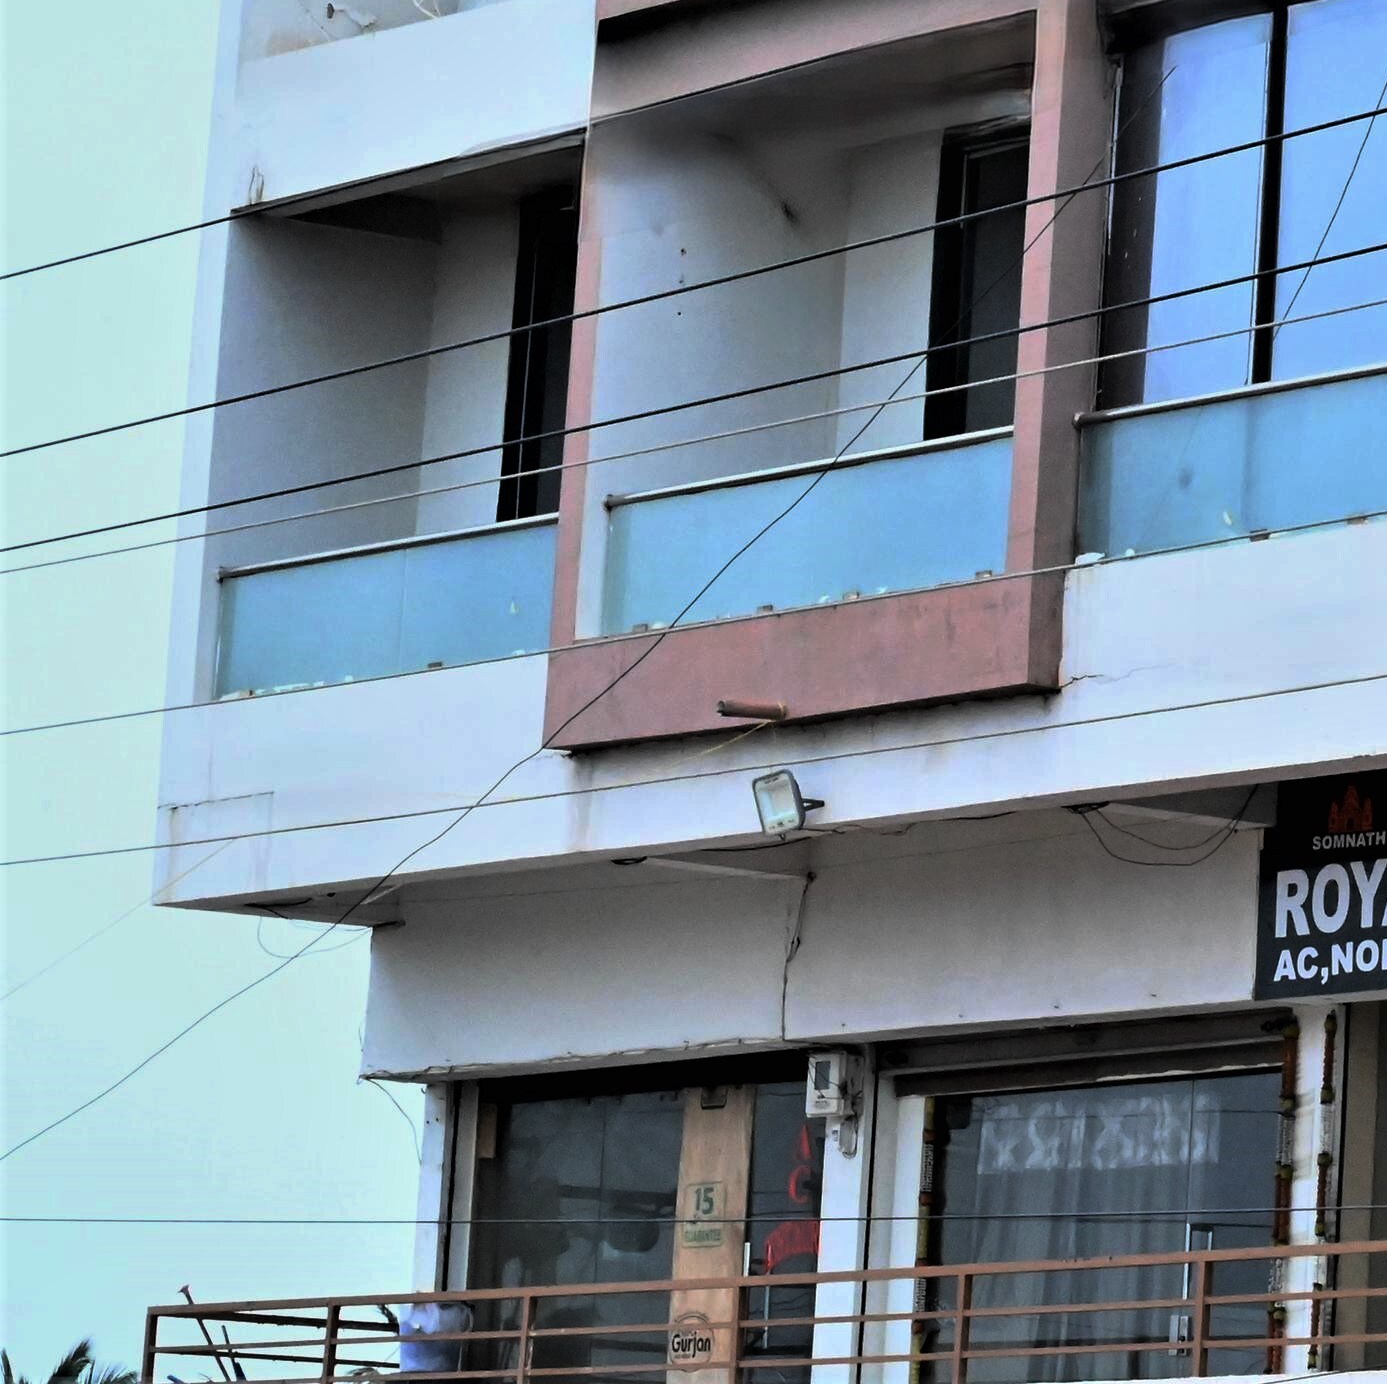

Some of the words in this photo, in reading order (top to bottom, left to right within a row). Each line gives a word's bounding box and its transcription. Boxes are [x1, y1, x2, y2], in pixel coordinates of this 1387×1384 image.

[1313, 831, 1386, 850] SOMNATH
[695, 1187, 714, 1214] 15
[672, 1331, 711, 1358] Gurjan
